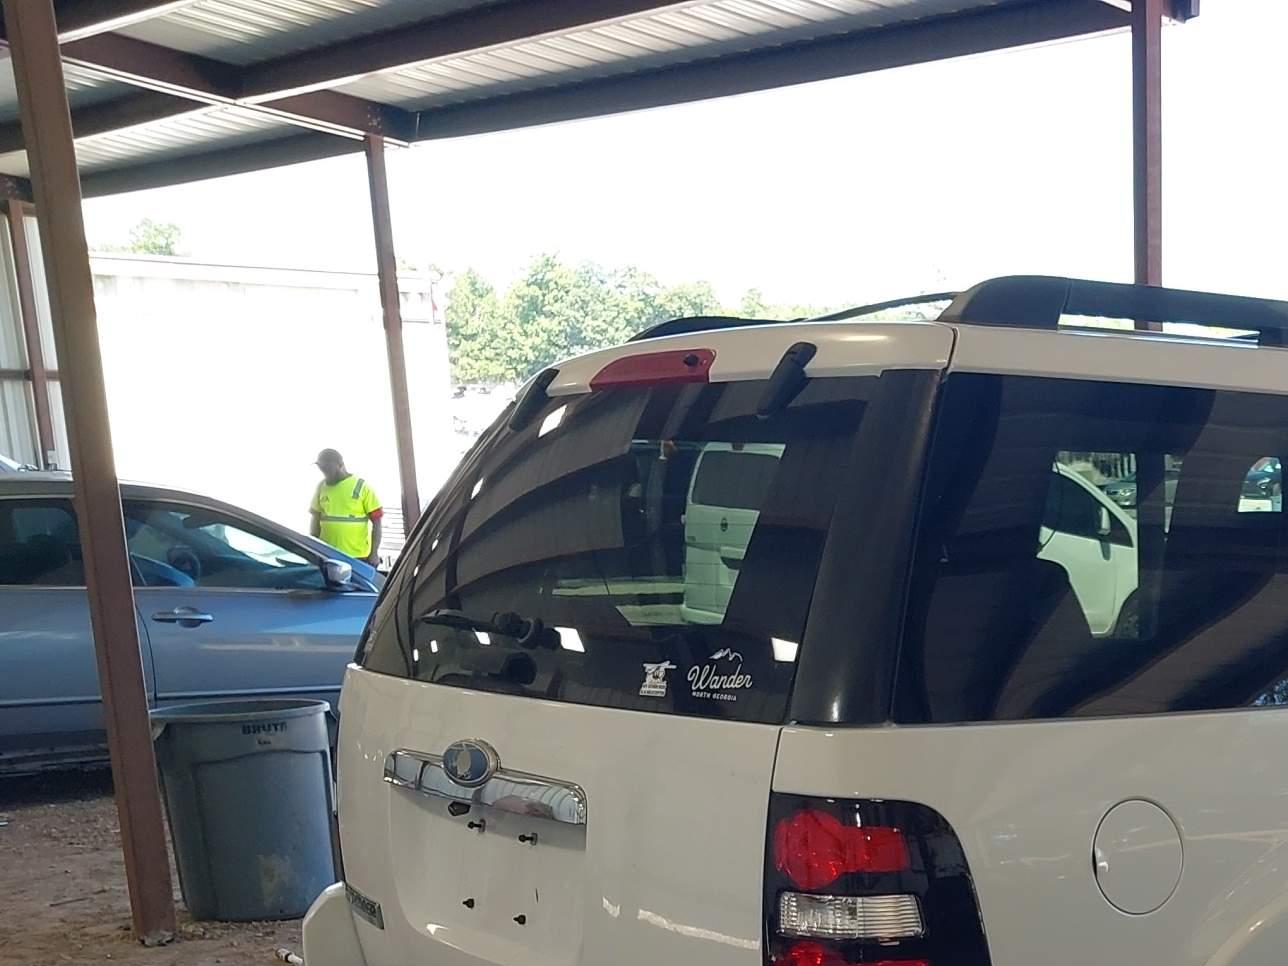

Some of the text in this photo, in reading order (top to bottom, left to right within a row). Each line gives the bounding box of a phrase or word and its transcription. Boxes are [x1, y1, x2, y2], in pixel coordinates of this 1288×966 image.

[687, 663, 753, 691] Wander
[692, 690, 737, 702] NORTH GEORGIA
